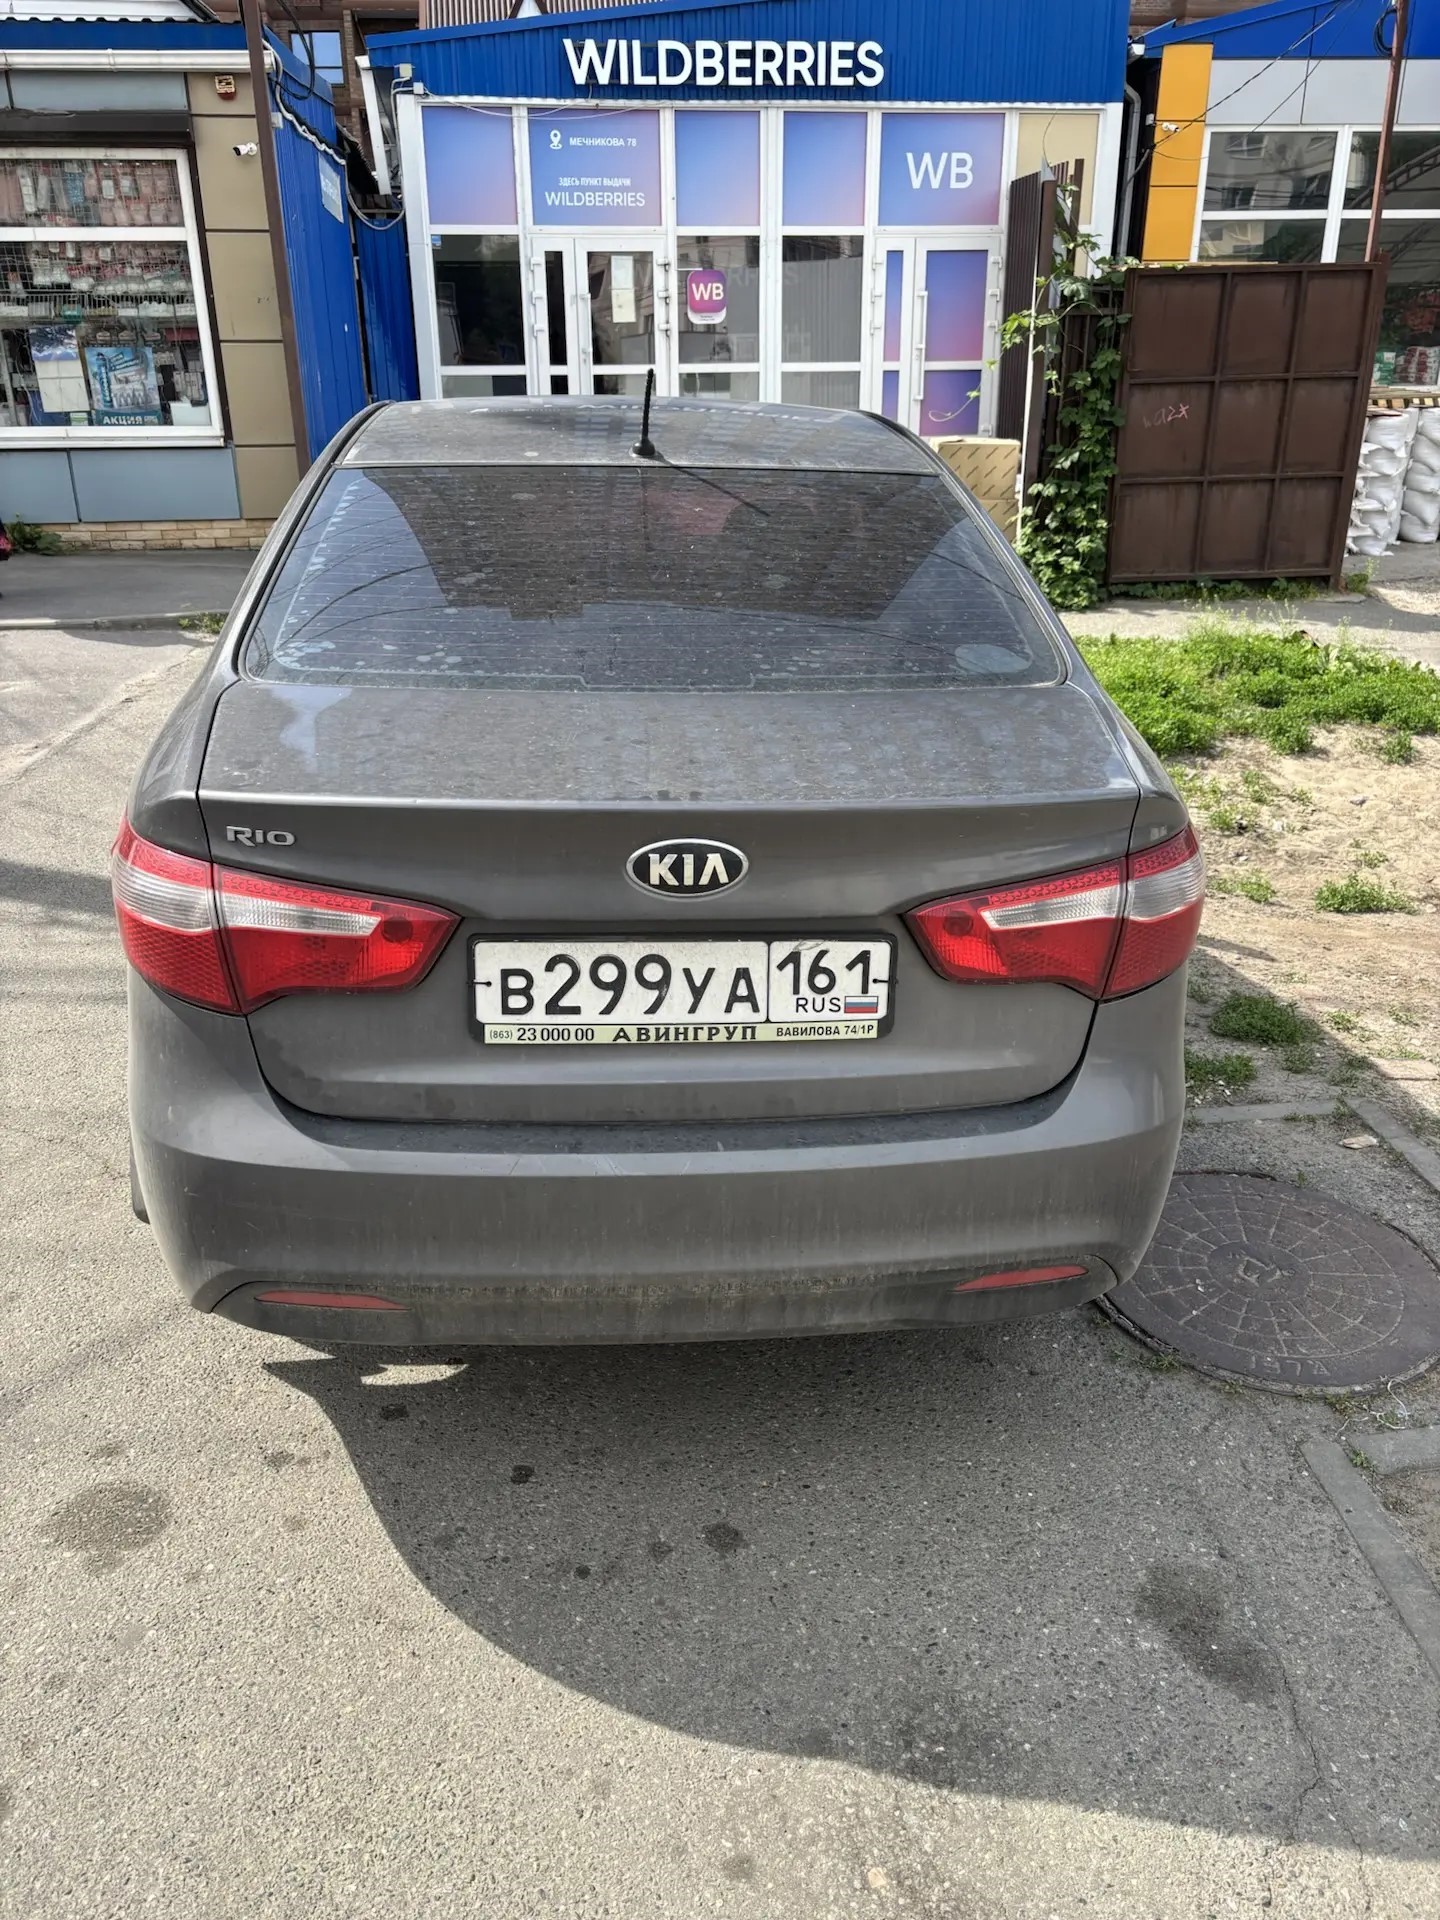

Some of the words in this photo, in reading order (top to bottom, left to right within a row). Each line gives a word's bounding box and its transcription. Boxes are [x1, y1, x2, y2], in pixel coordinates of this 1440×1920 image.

[562, 38, 885, 87] WILDBERRIES
[569, 137, 625, 147] МЕЧНИКОВА
[627, 138, 637, 147] 78
[905, 152, 974, 190] WB
[558, 177, 579, 187] ЗДЕСЬ
[580, 177, 602, 186] ПУНКТ
[603, 178, 631, 187] ВЫДАЧИ
[544, 191, 646, 207] WILDBERRIES
[691, 282, 725, 301] WB
[103, 415, 143, 425] АКЦИЯ
[226, 825, 295, 847] RIO
[648, 852, 730, 886] KIA
[776, 949, 871, 995] 161
[796, 997, 841, 1013] RUS
[489, 1028, 513, 1040] (863)
[517, 1027, 537, 1042] 23
[541, 1027, 571, 1042] 000
[575, 1027, 595, 1041] 00
[612, 1025, 758, 1043] АВИНГРУП
[776, 1026, 840, 1038] ВАВИЛОВА
